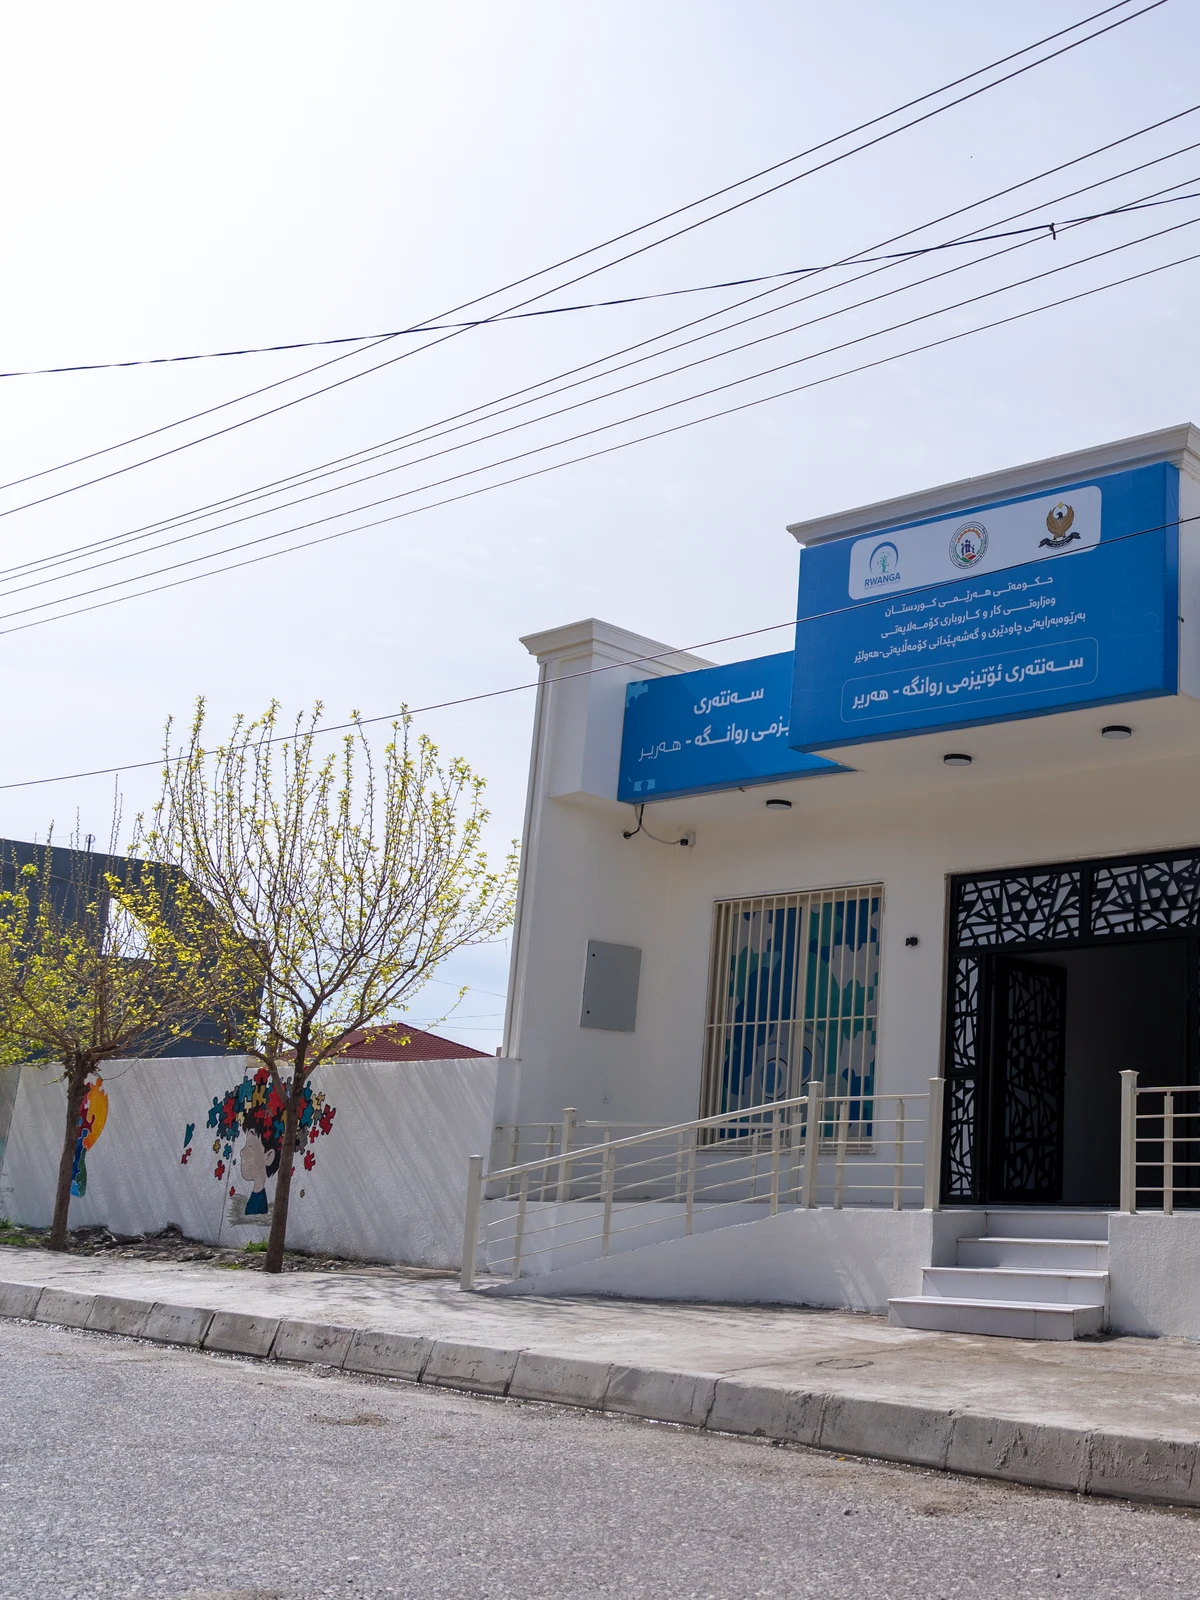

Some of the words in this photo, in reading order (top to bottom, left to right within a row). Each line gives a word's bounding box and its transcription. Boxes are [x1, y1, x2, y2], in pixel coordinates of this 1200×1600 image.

[864, 572, 901, 587] RWANGA
[982, 610, 988, 619] و
[981, 631, 987, 641] و
